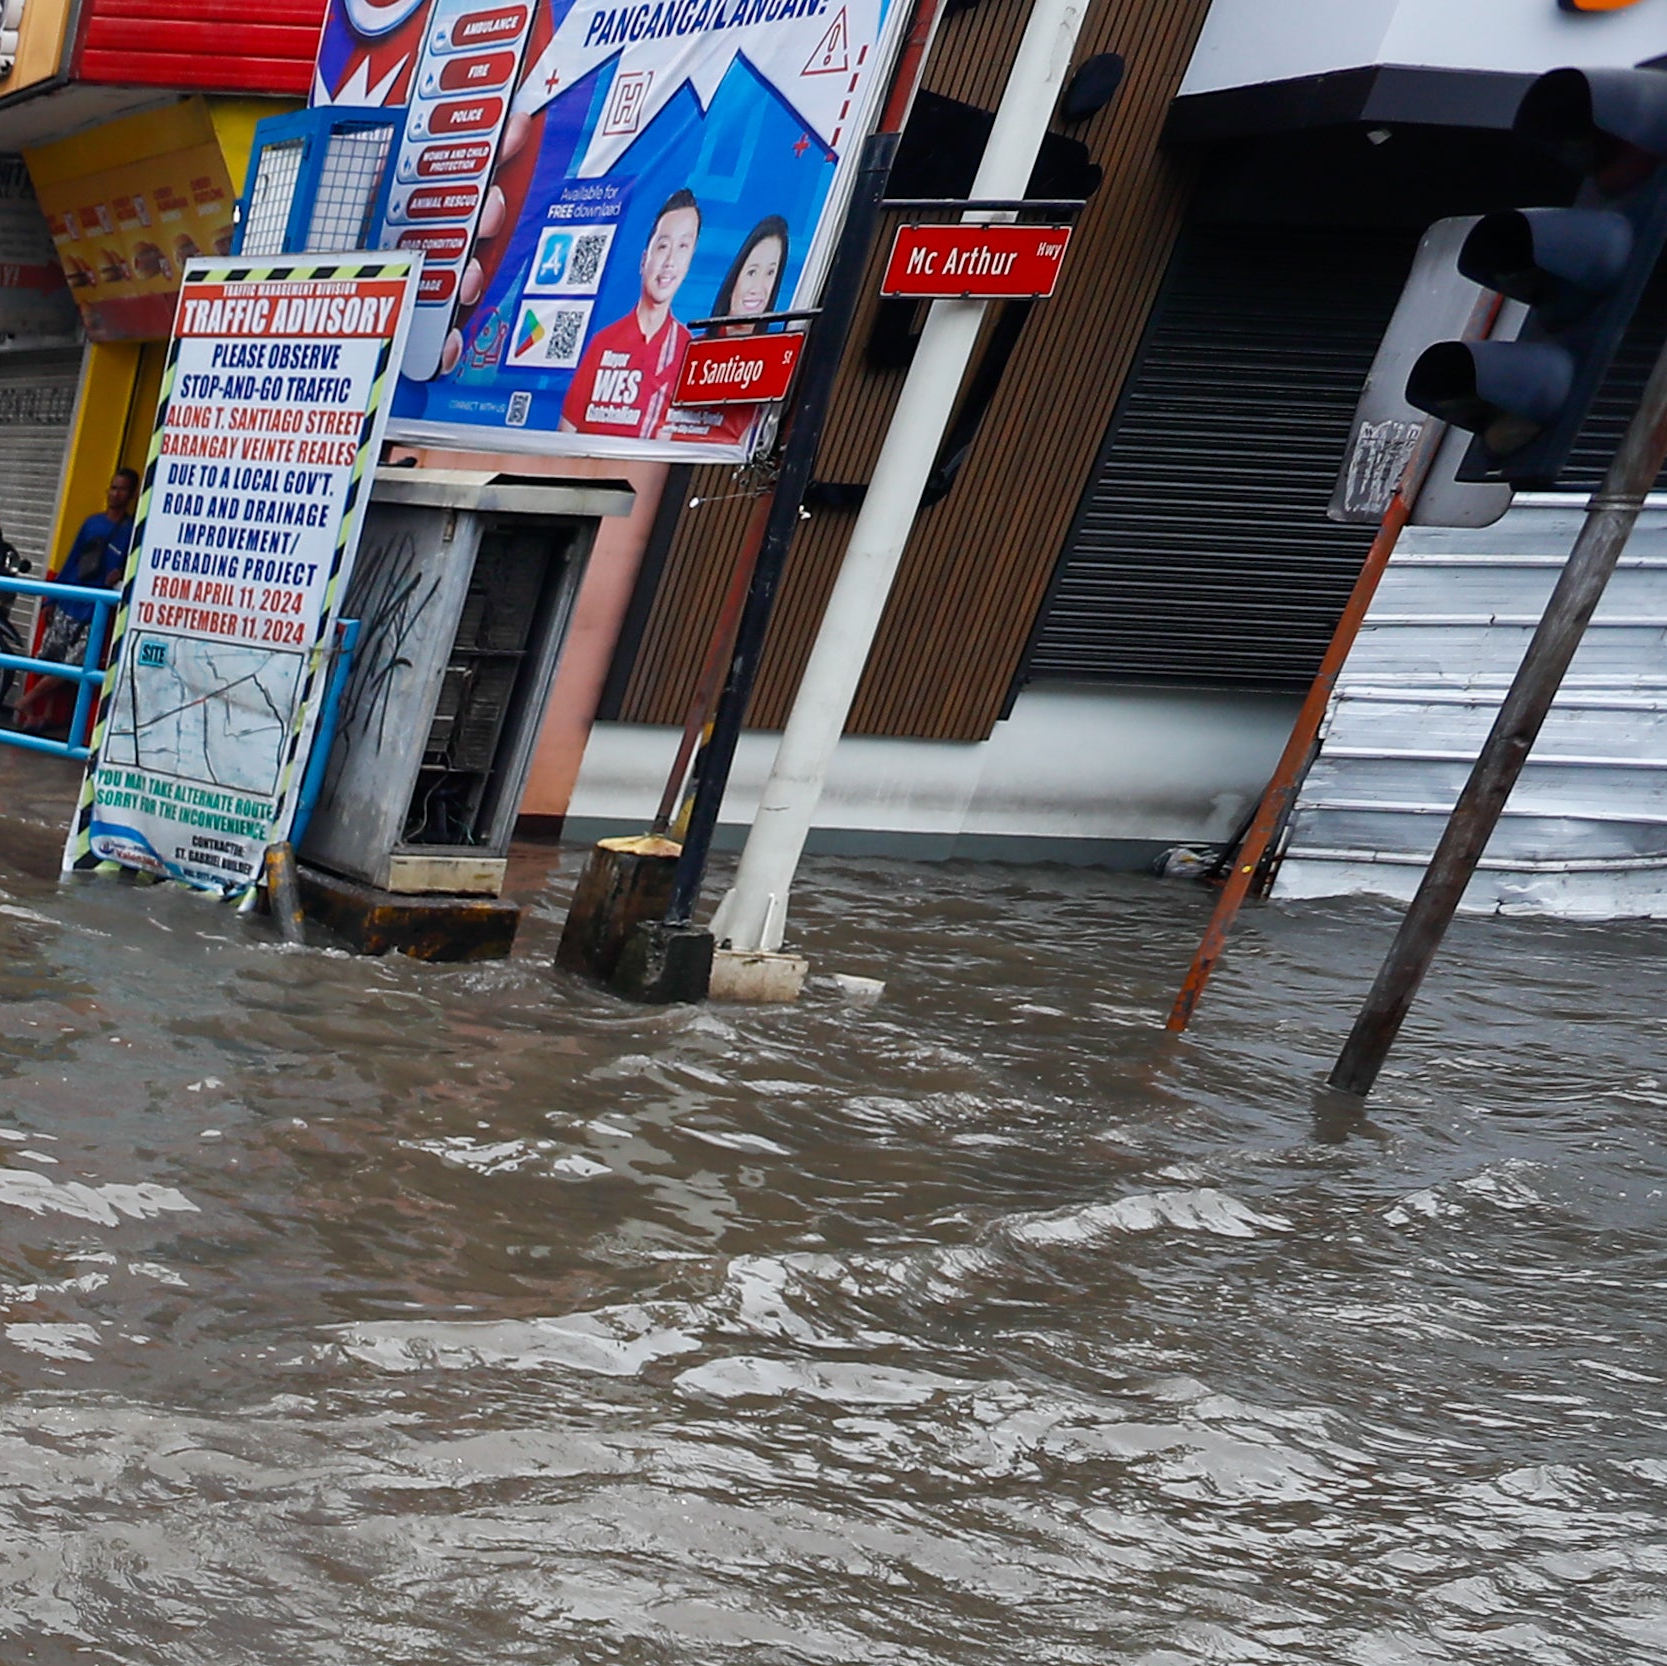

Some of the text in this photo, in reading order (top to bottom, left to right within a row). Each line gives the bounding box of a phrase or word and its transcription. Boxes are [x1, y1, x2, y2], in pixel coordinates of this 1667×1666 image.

[463, 16, 520, 36] AMBULANCE
[467, 64, 491, 79] FIRE
[450, 109, 483, 123] POLICE
[423, 146, 490, 161] WOMEN AND CHILD
[429, 160, 477, 172] PROTECTION
[410, 194, 478, 209] ANIMAL RESCUE
[560, 184, 620, 201] Available for
[547, 202, 622, 218] FREE download
[422, 238, 465, 249] CONDITION
[906, 242, 1063, 275] Mc Arthur Hwy
[223, 282, 358, 297] TRAFFIC MANAGEMENT DIVISION
[182, 296, 396, 335] TRAFFIC ADVISORY
[211, 343, 342, 370] PLEASE OBSERVE
[599, 350, 630, 368] Mayor
[687, 350, 793, 389] T. Santiago St
[180, 374, 352, 404] STOP-AND-GO TRAFFIC
[593, 369, 643, 403] WES
[165, 404, 365, 435] ALONG T. SANTIAGO STREET
[585, 403, 641, 426] Gatchalian
[160, 434, 358, 467] BARANGAY VEINTE REALES
[167, 463, 334, 497] DUE TO A LOCAL GOV'T.
[163, 493, 330, 528] ROAD AND DRAINAGE
[177, 523, 301, 555] IMPROVEMENT/
[151, 549, 318, 587] UPGRADING PROJECT
[151, 575, 304, 615] FROM APRIL 11, 2024
[137, 602, 306, 645] TO SEPTEMBER 11, 2024
[142, 643, 167, 664] SITE
[97, 769, 122, 787] YOU
[149, 778, 173, 798] TAKE
[175, 786, 233, 813] ALTERNATE
[97, 788, 139, 810] SORRY
[139, 797, 157, 814] FOR
[158, 800, 177, 820] THE
